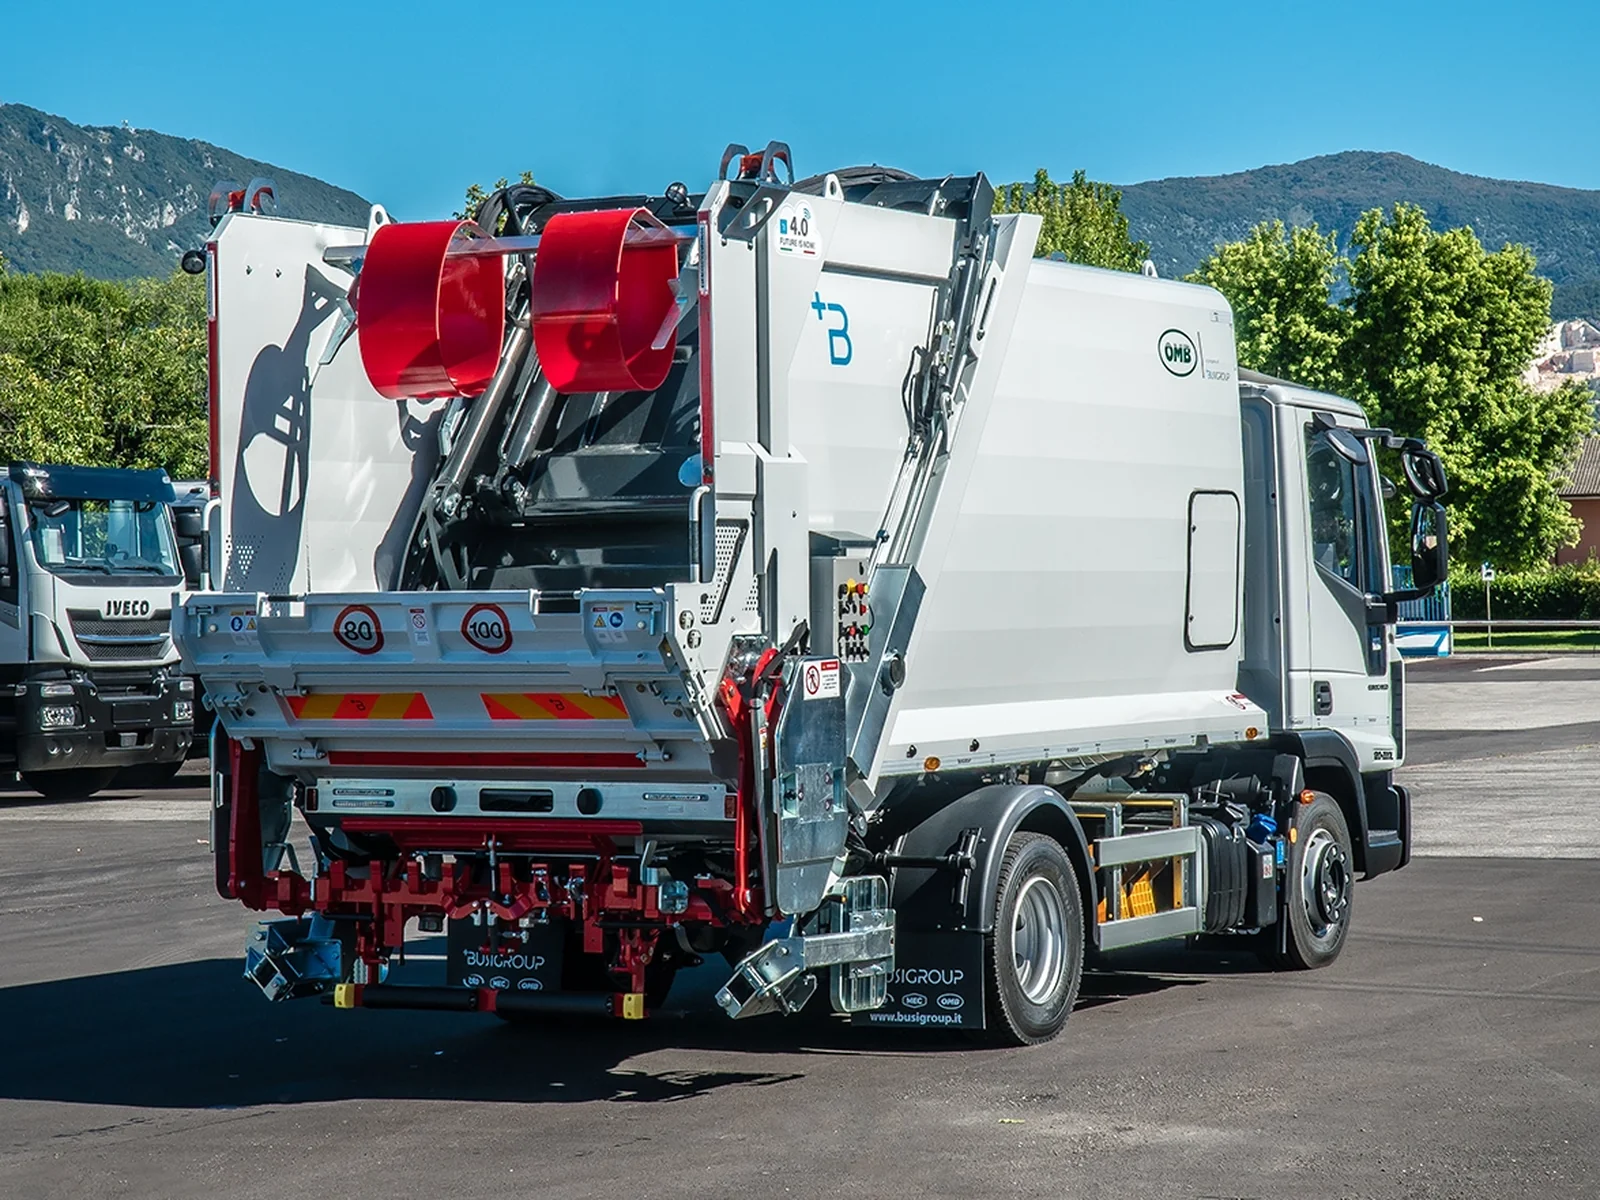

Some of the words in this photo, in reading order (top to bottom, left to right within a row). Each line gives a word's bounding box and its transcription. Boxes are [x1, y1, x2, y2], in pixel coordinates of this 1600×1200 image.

[790, 216, 808, 236] 4.0
[1164, 342, 1191, 363] OMB
[106, 600, 150, 616] IVECO
[344, 620, 373, 641] 80
[469, 621, 504, 640] 100
[466, 950, 546, 971] BUSIGROUP
[886, 968, 964, 985] USIGROUP
[870, 1011, 963, 1026] www.busigroup.it
